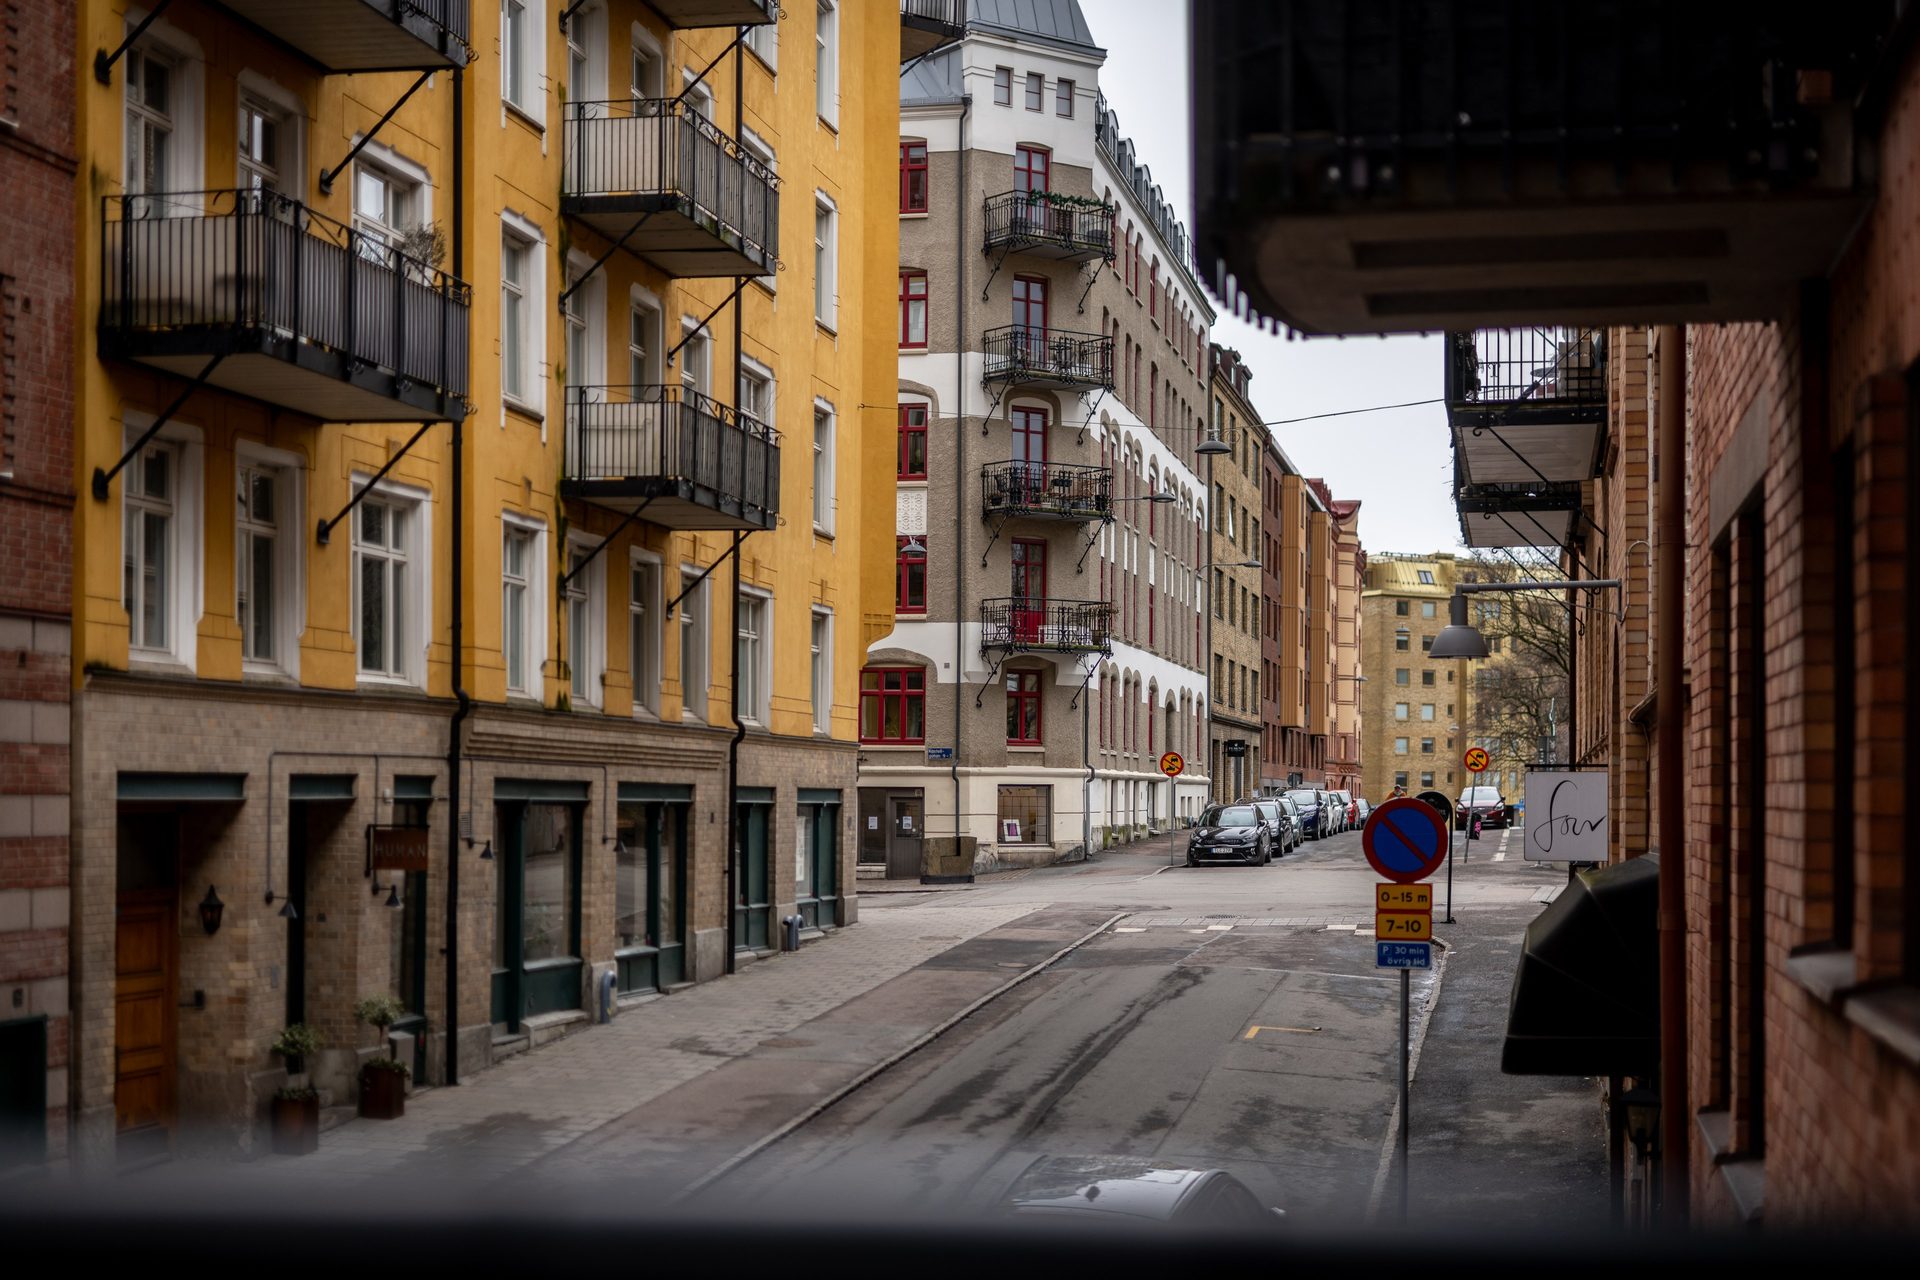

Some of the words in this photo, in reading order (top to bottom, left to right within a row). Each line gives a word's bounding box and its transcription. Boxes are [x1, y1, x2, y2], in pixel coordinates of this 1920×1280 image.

[375, 843, 426, 857] HUMAN
[1417, 894, 1428, 902] m
[1386, 919, 1421, 933] 7-10
[1383, 946, 1389, 954] P
[1395, 946, 1407, 955] 30
[1409, 947, 1425, 955] min
[1387, 957, 1411, 966] övrig
[1412, 957, 1425, 966] tid
